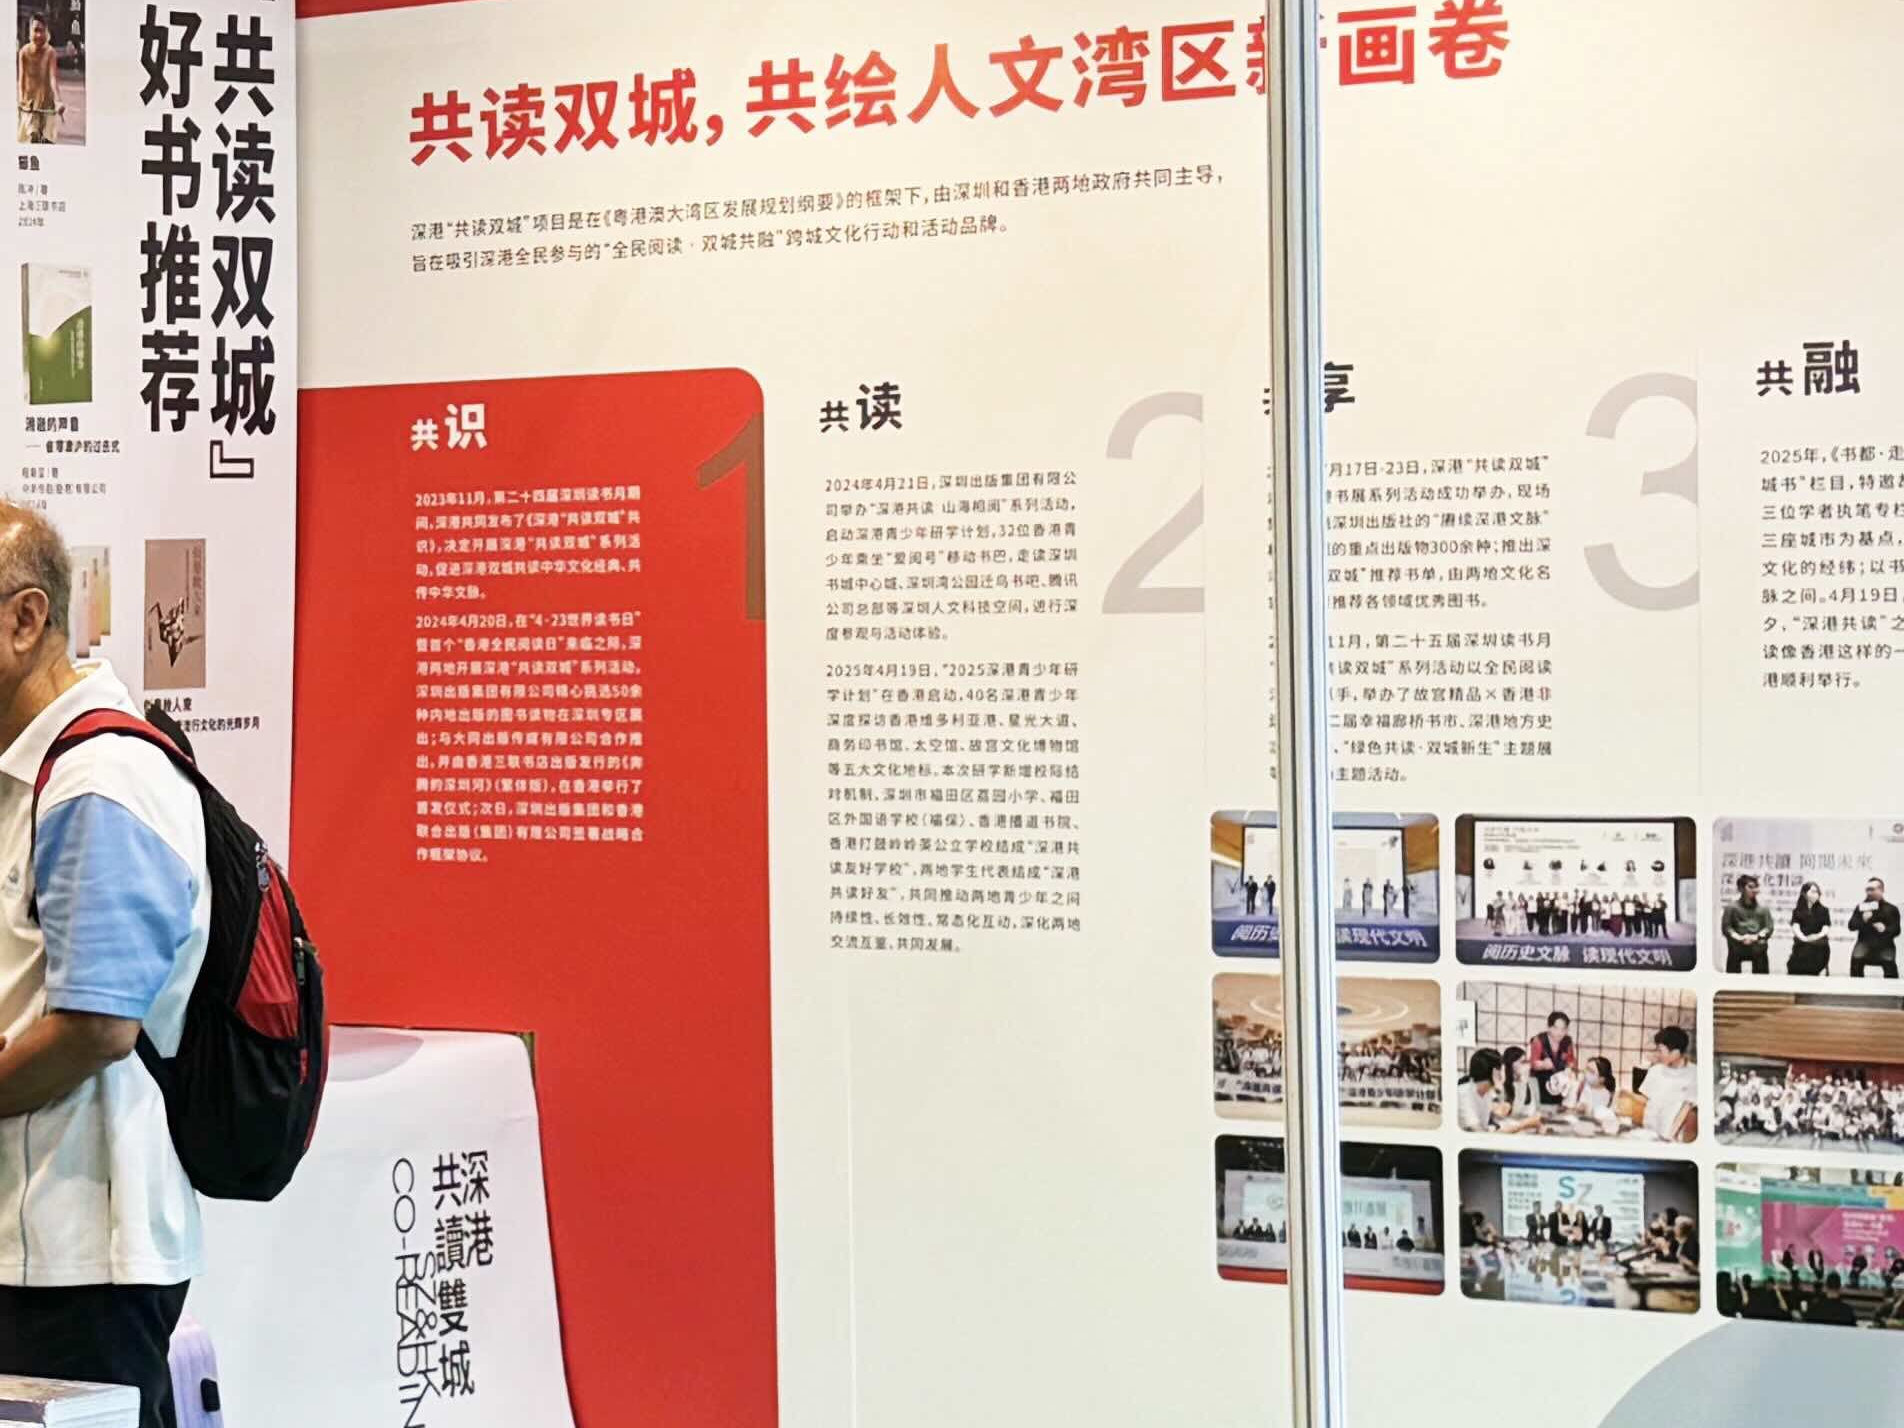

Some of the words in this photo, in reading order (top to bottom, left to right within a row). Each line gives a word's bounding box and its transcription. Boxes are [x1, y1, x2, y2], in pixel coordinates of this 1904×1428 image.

[140, 4, 203, 433] 好书推荐
[410, 404, 488, 451] 共识
[819, 382, 903, 432] 共读
[1756, 340, 1861, 397] 共融
[1102, 390, 1204, 614] 2
[1584, 372, 1699, 611] 3
[432, 1152, 474, 1397] 共讀雙城
[460, 1150, 494, 1267] 深港
